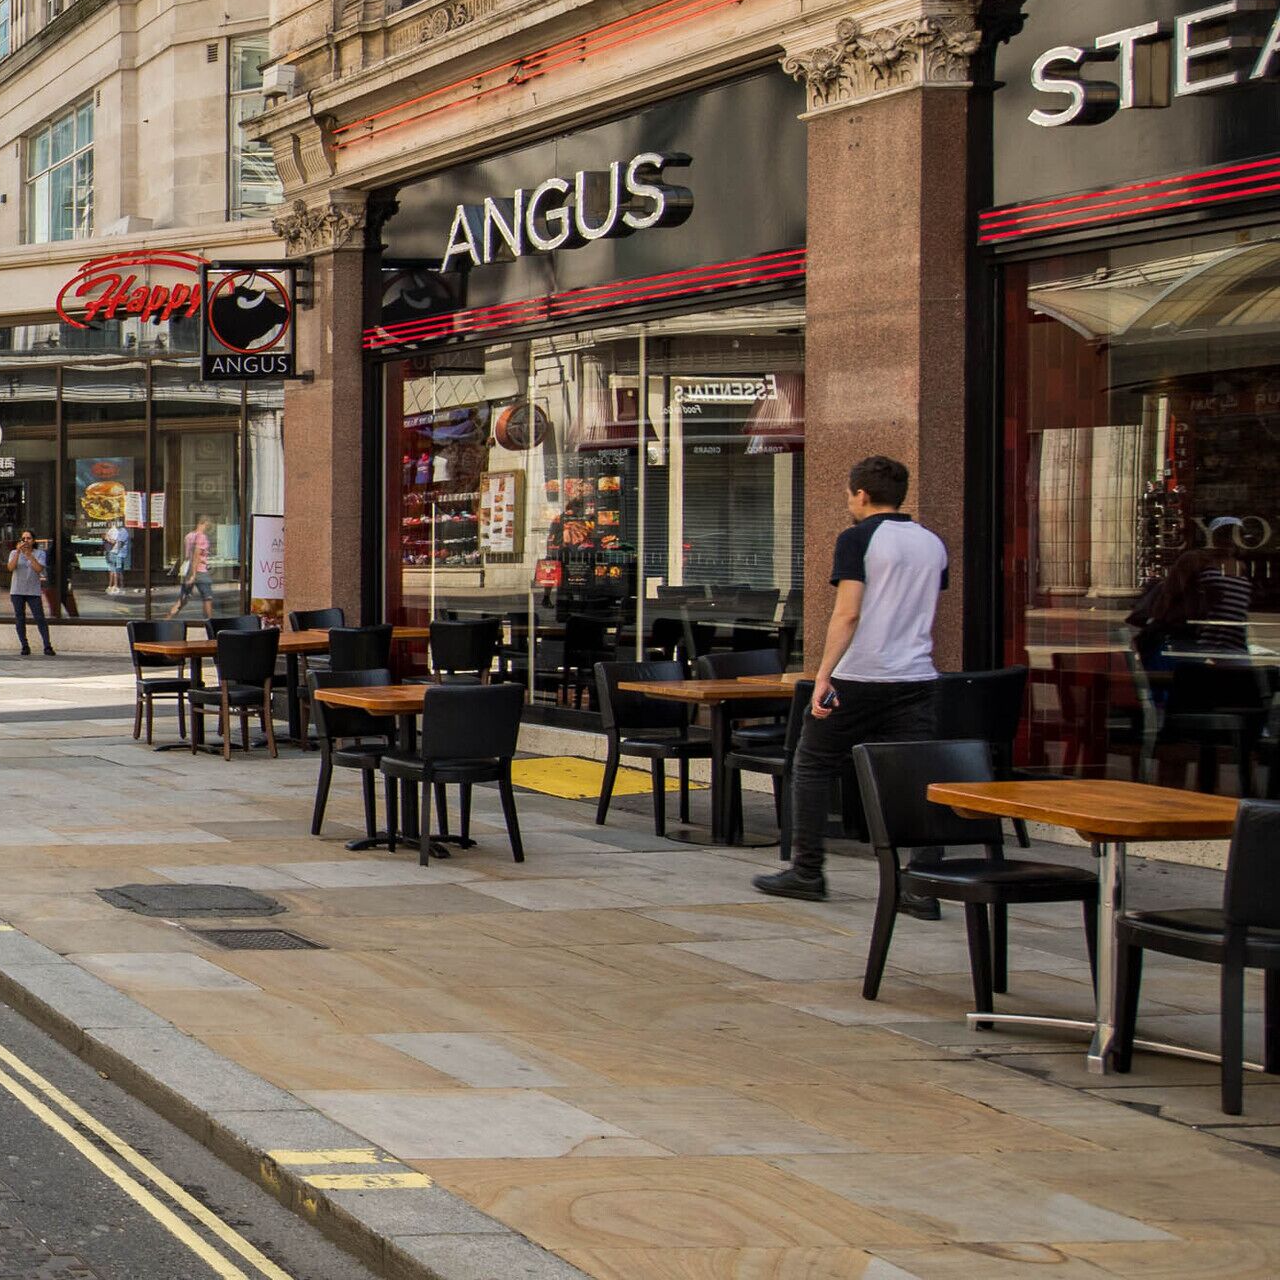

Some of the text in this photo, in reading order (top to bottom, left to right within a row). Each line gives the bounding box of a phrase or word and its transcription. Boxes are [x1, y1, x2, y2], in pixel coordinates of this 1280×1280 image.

[441, 152, 666, 273] ANGUS
[75, 274, 214, 323] Happy
[211, 355, 288, 373] ANGUS
[260, 561, 282, 574] WE
